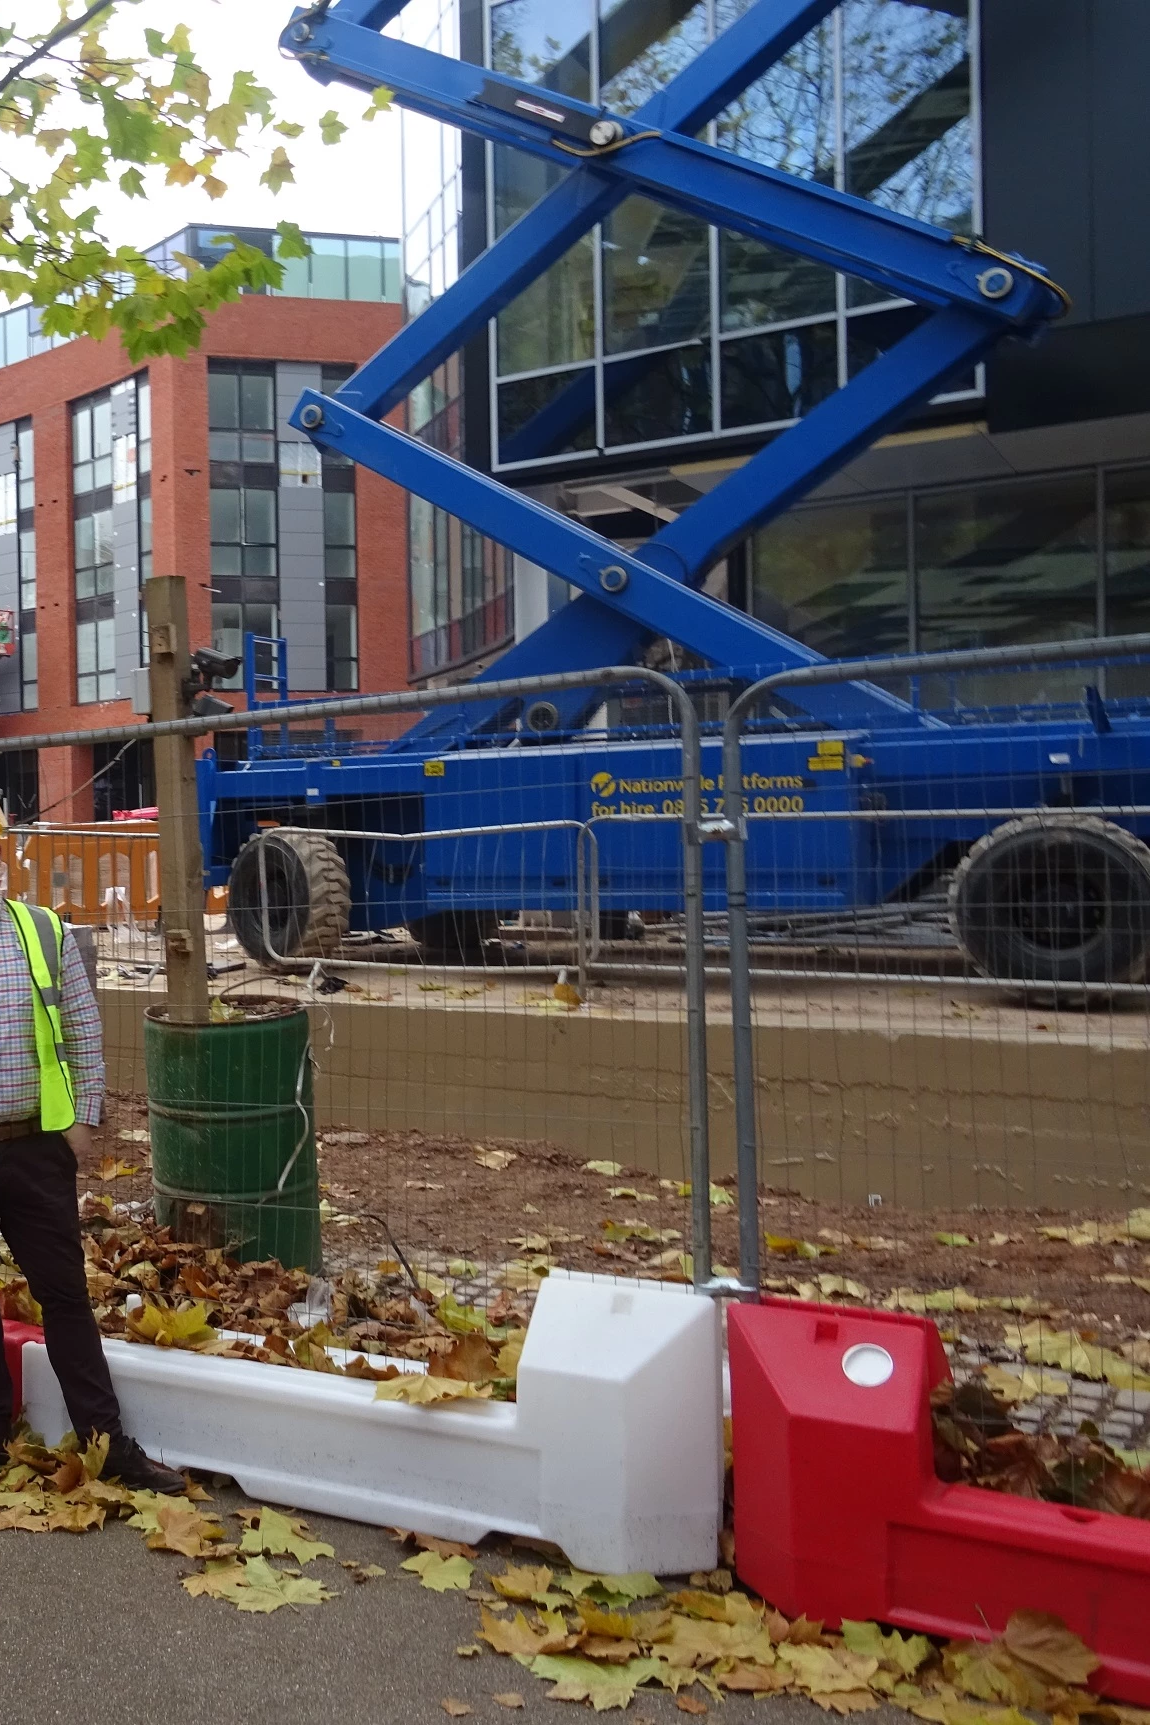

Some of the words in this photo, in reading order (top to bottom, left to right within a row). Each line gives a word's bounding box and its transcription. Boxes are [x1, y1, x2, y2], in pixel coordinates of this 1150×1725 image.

[619, 774, 715, 794] Nationwe
[718, 772, 804, 791] tforms
[591, 801, 617, 817] for
[662, 799, 709, 814] 085
[713, 797, 749, 814] 75
[753, 796, 804, 813] 0000
